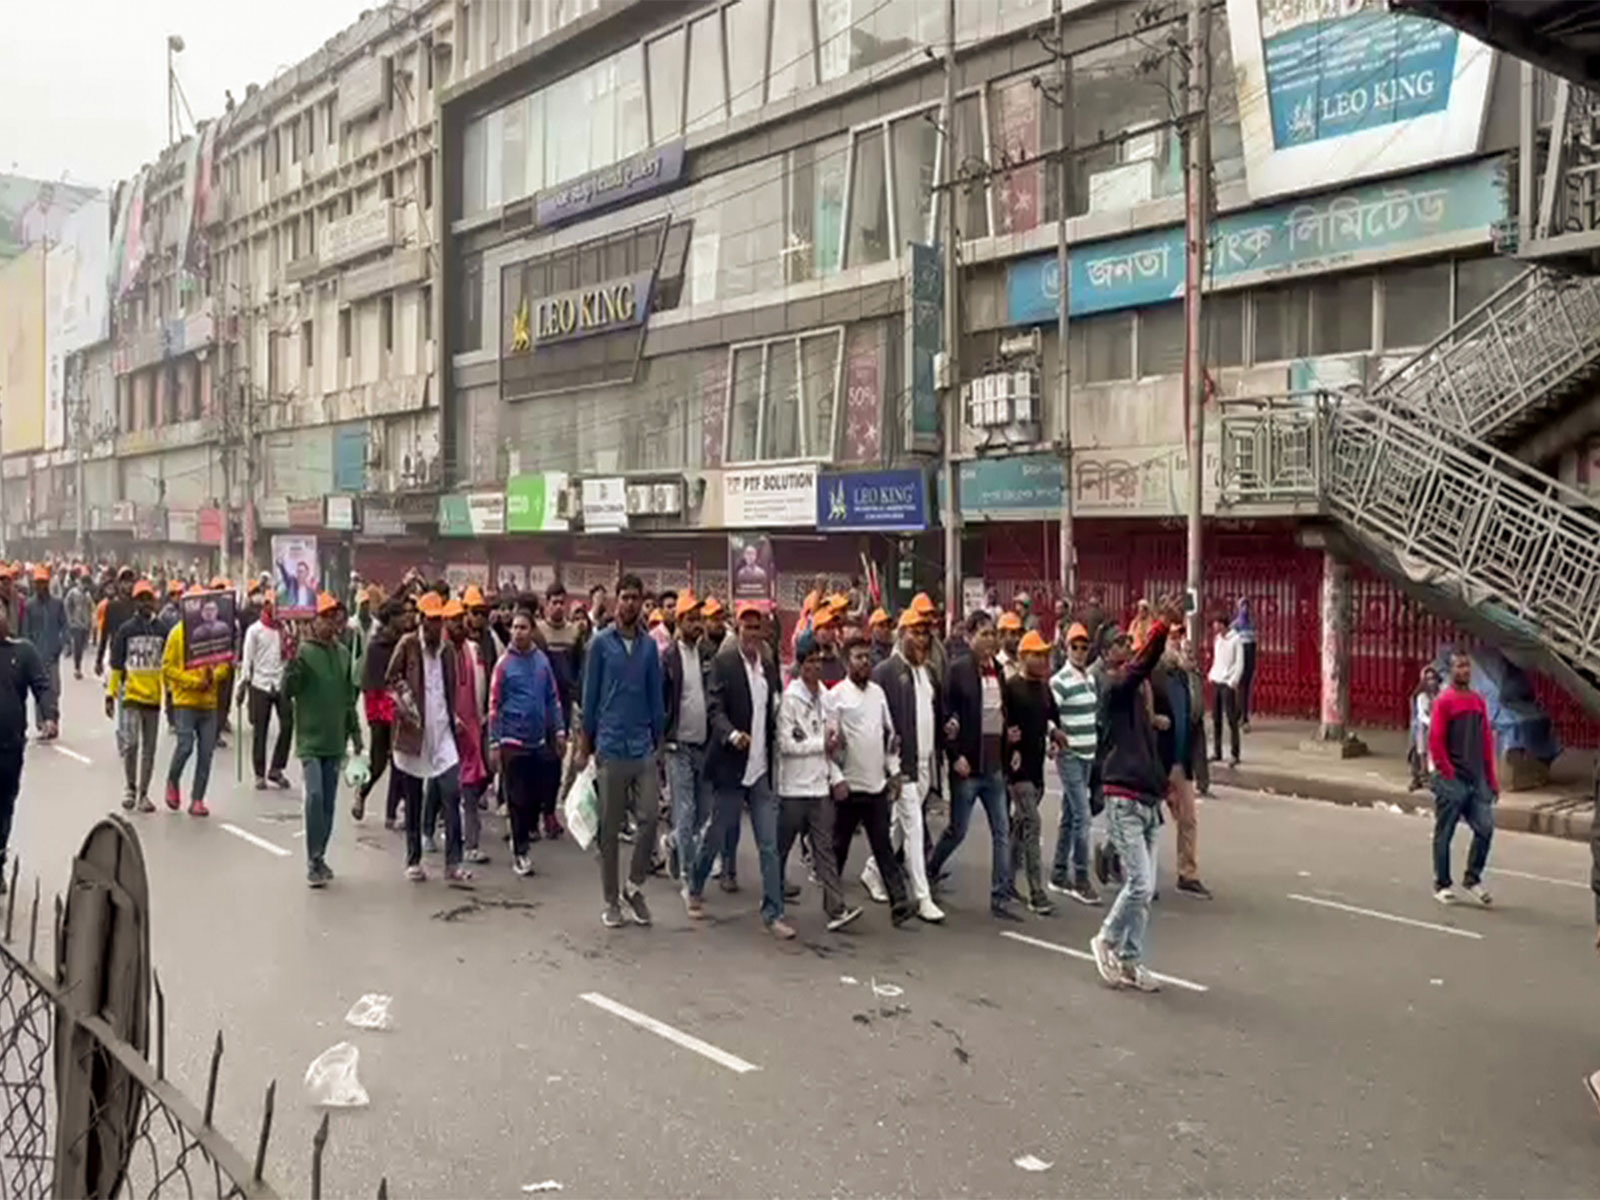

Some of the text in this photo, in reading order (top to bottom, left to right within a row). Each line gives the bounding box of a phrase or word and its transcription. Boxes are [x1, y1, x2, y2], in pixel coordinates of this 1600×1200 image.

[1319, 70, 1436, 121] LEO KING
[1085, 250, 1169, 288] জনতা
[1283, 187, 1449, 252] লিমিটেড
[535, 280, 634, 339] LEO KING
[762, 471, 814, 491] SOLUTION
[853, 484, 914, 505] LEO KING
